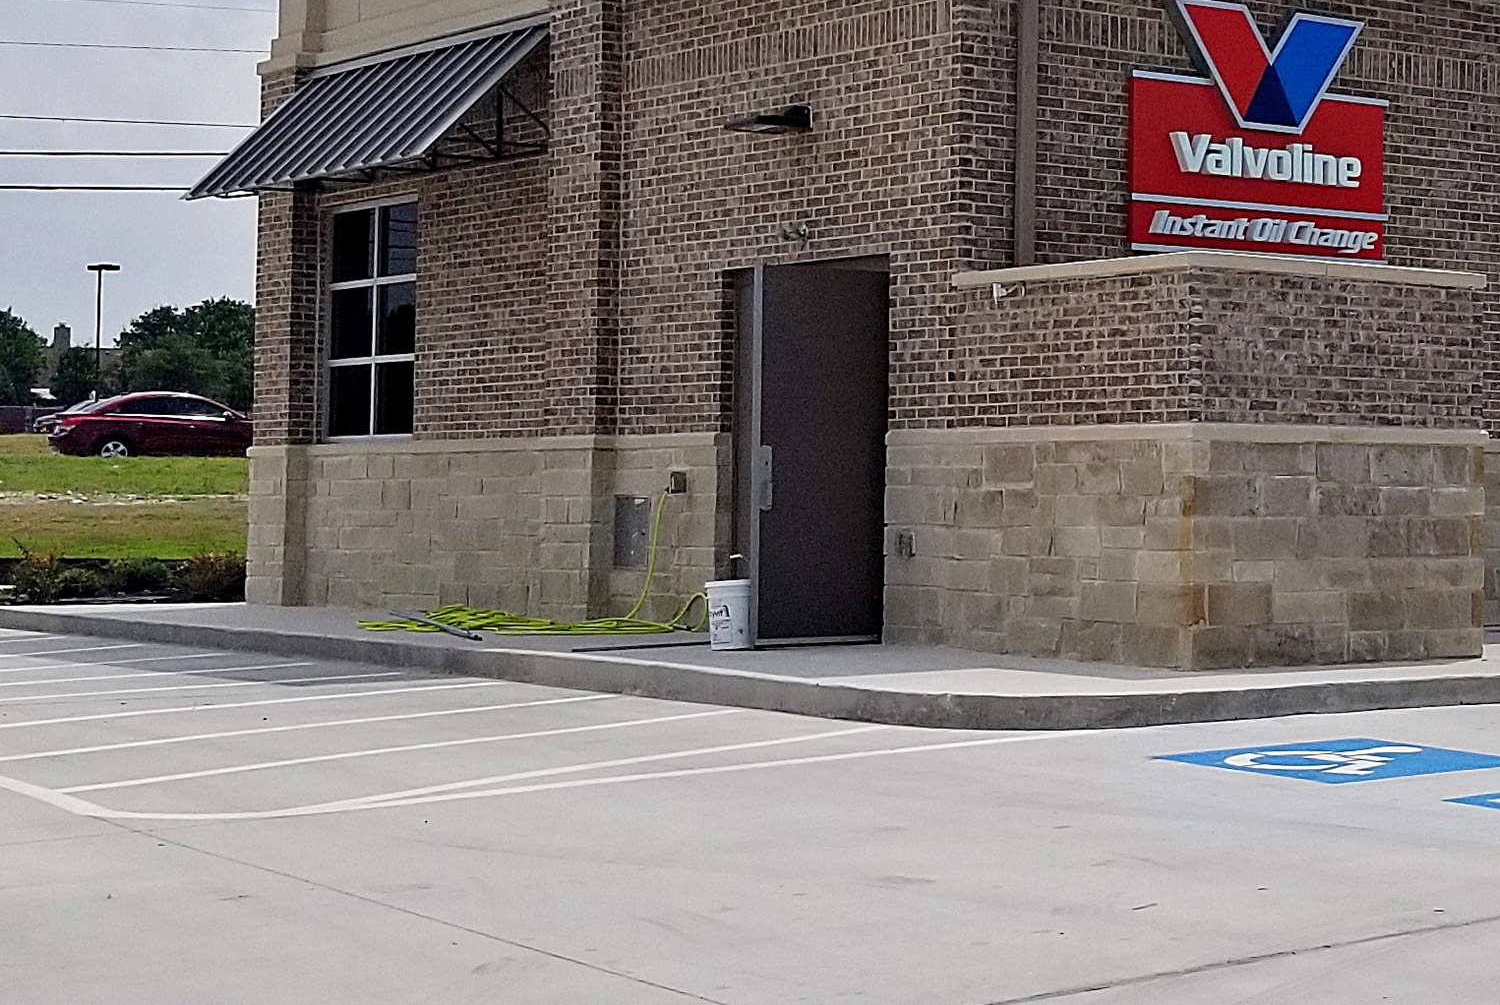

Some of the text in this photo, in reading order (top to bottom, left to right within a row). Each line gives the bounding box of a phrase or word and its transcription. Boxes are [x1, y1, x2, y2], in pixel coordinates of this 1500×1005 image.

[1169, 131, 1362, 188] Valvoline
[1149, 210, 1379, 254] Instant Oil Change
